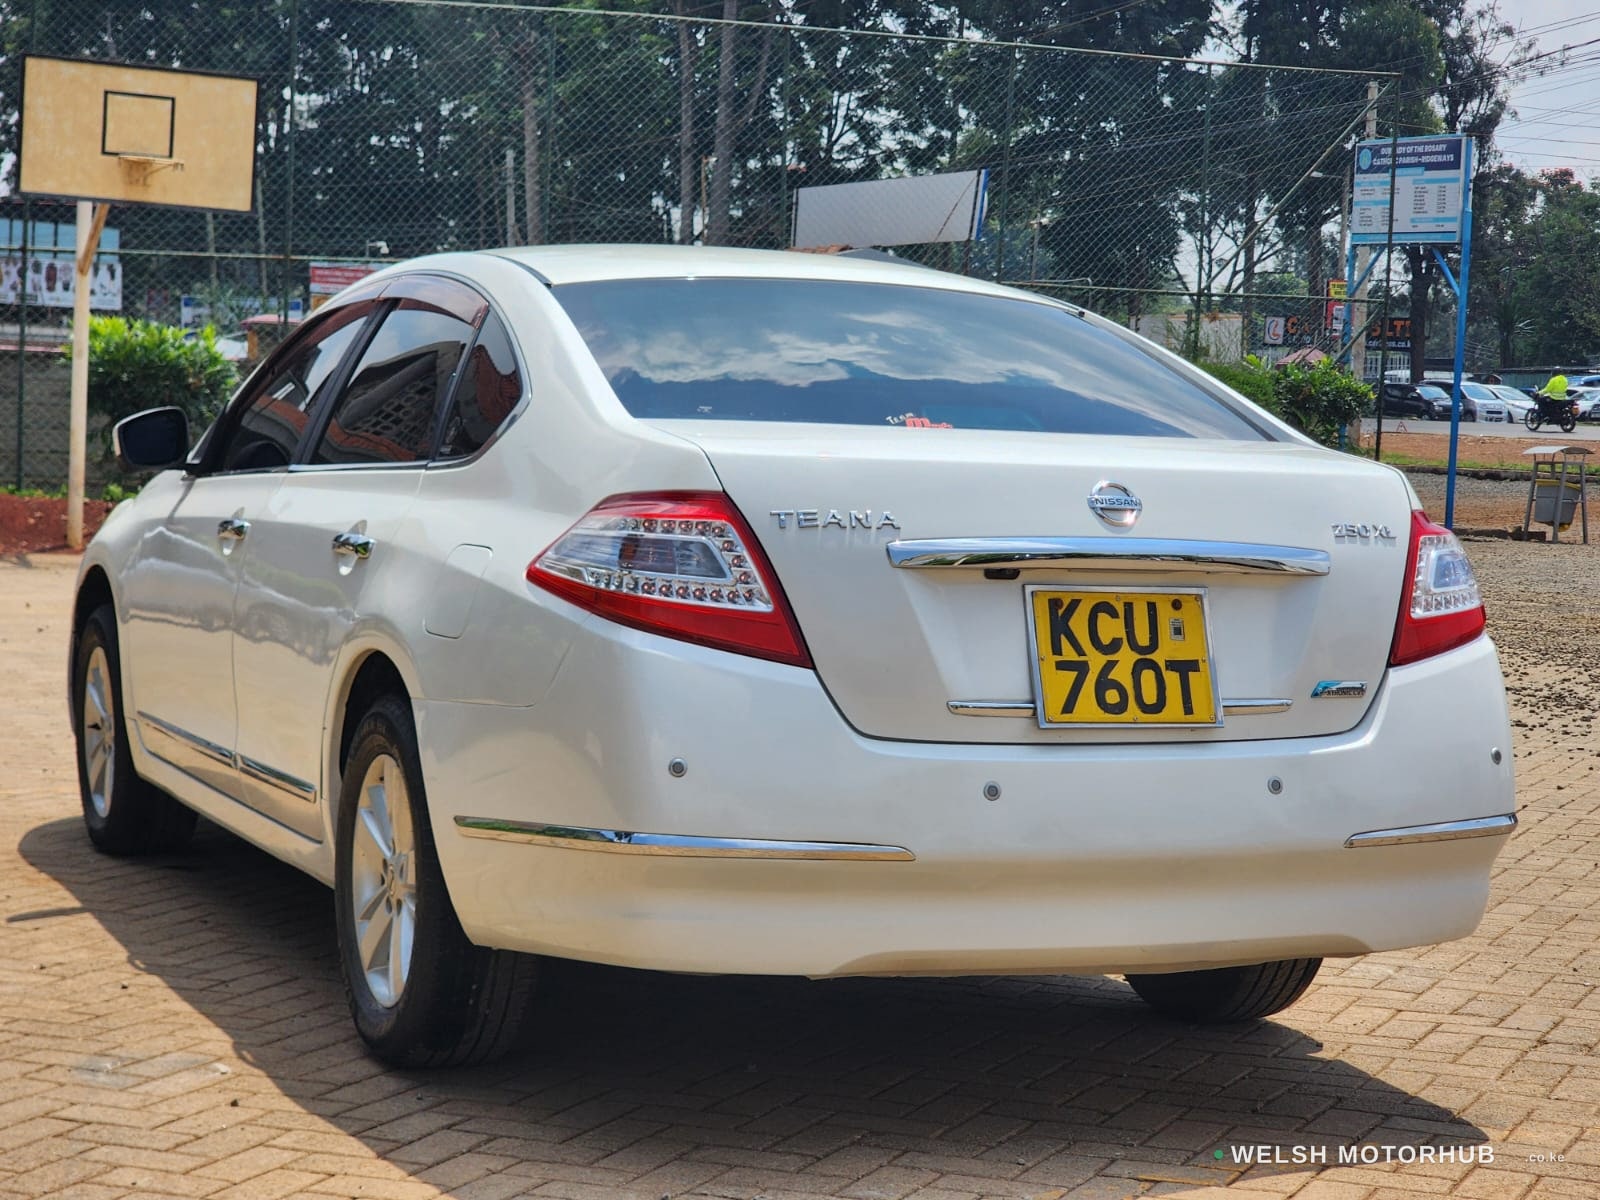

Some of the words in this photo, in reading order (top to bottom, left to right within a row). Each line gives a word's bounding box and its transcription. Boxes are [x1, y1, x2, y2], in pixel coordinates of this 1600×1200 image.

[1414, 145, 1424, 153] THE
[1424, 144, 1448, 153] ROSARY
[1094, 497, 1138, 506] NISSAN
[769, 509, 901, 530] TEANA
[1047, 598, 1160, 657] KCU
[1054, 657, 1201, 716] 760T
